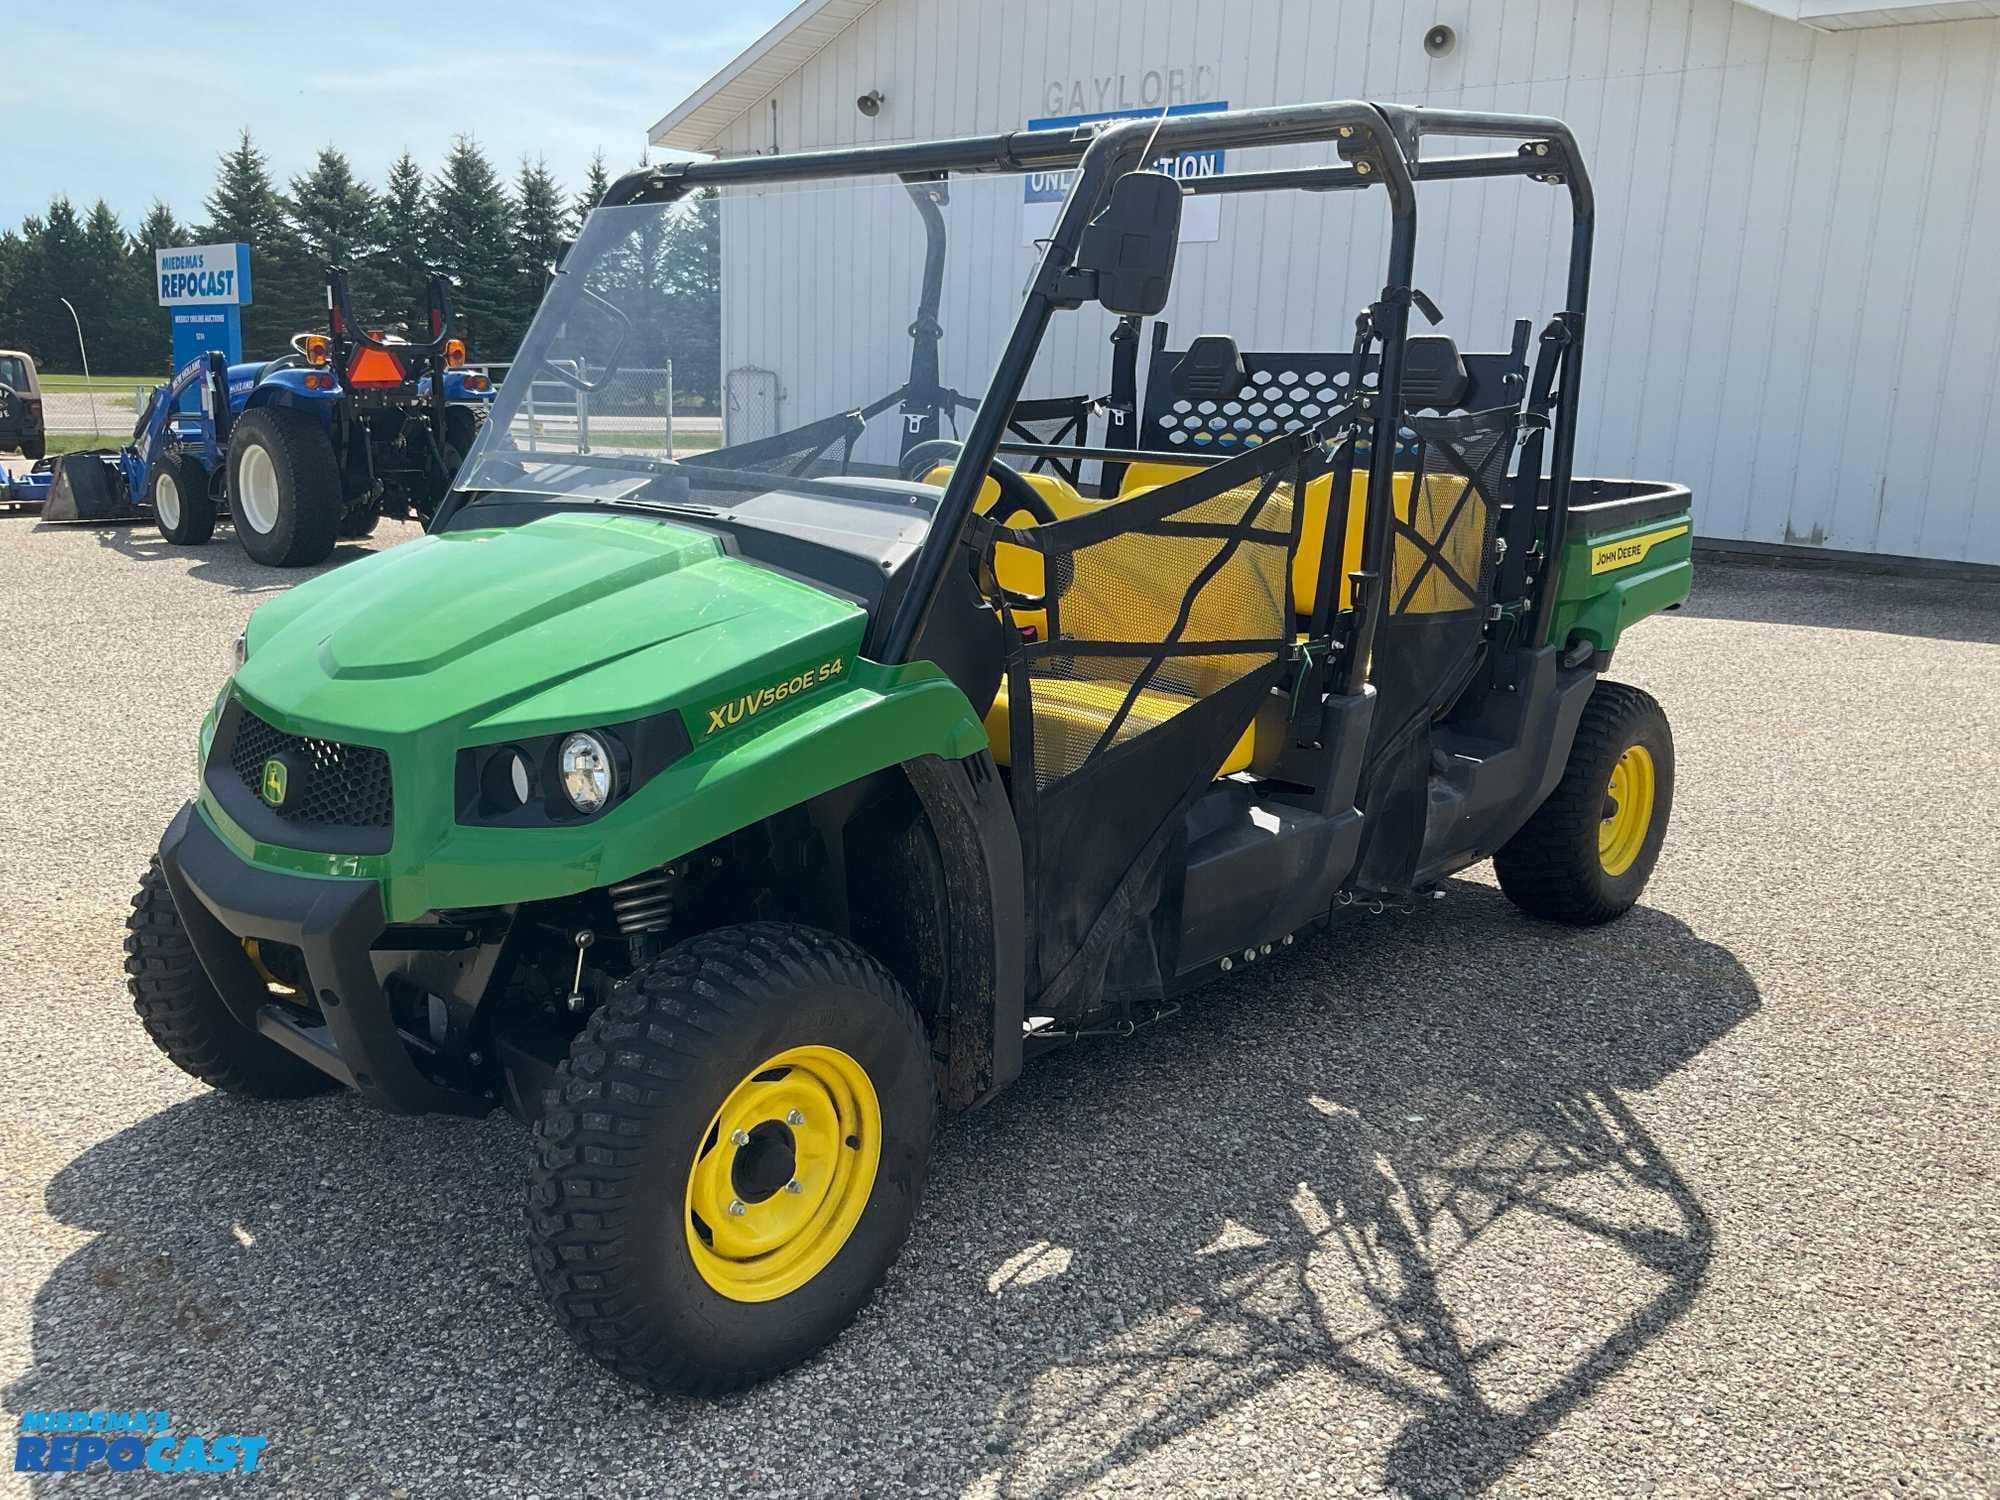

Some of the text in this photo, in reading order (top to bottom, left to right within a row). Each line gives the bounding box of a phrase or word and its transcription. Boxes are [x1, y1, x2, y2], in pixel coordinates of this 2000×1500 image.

[161, 254, 204, 270] MIEDEMA'S
[161, 271, 233, 297] REPOCAST
[705, 656, 843, 735] XUV560E S4
